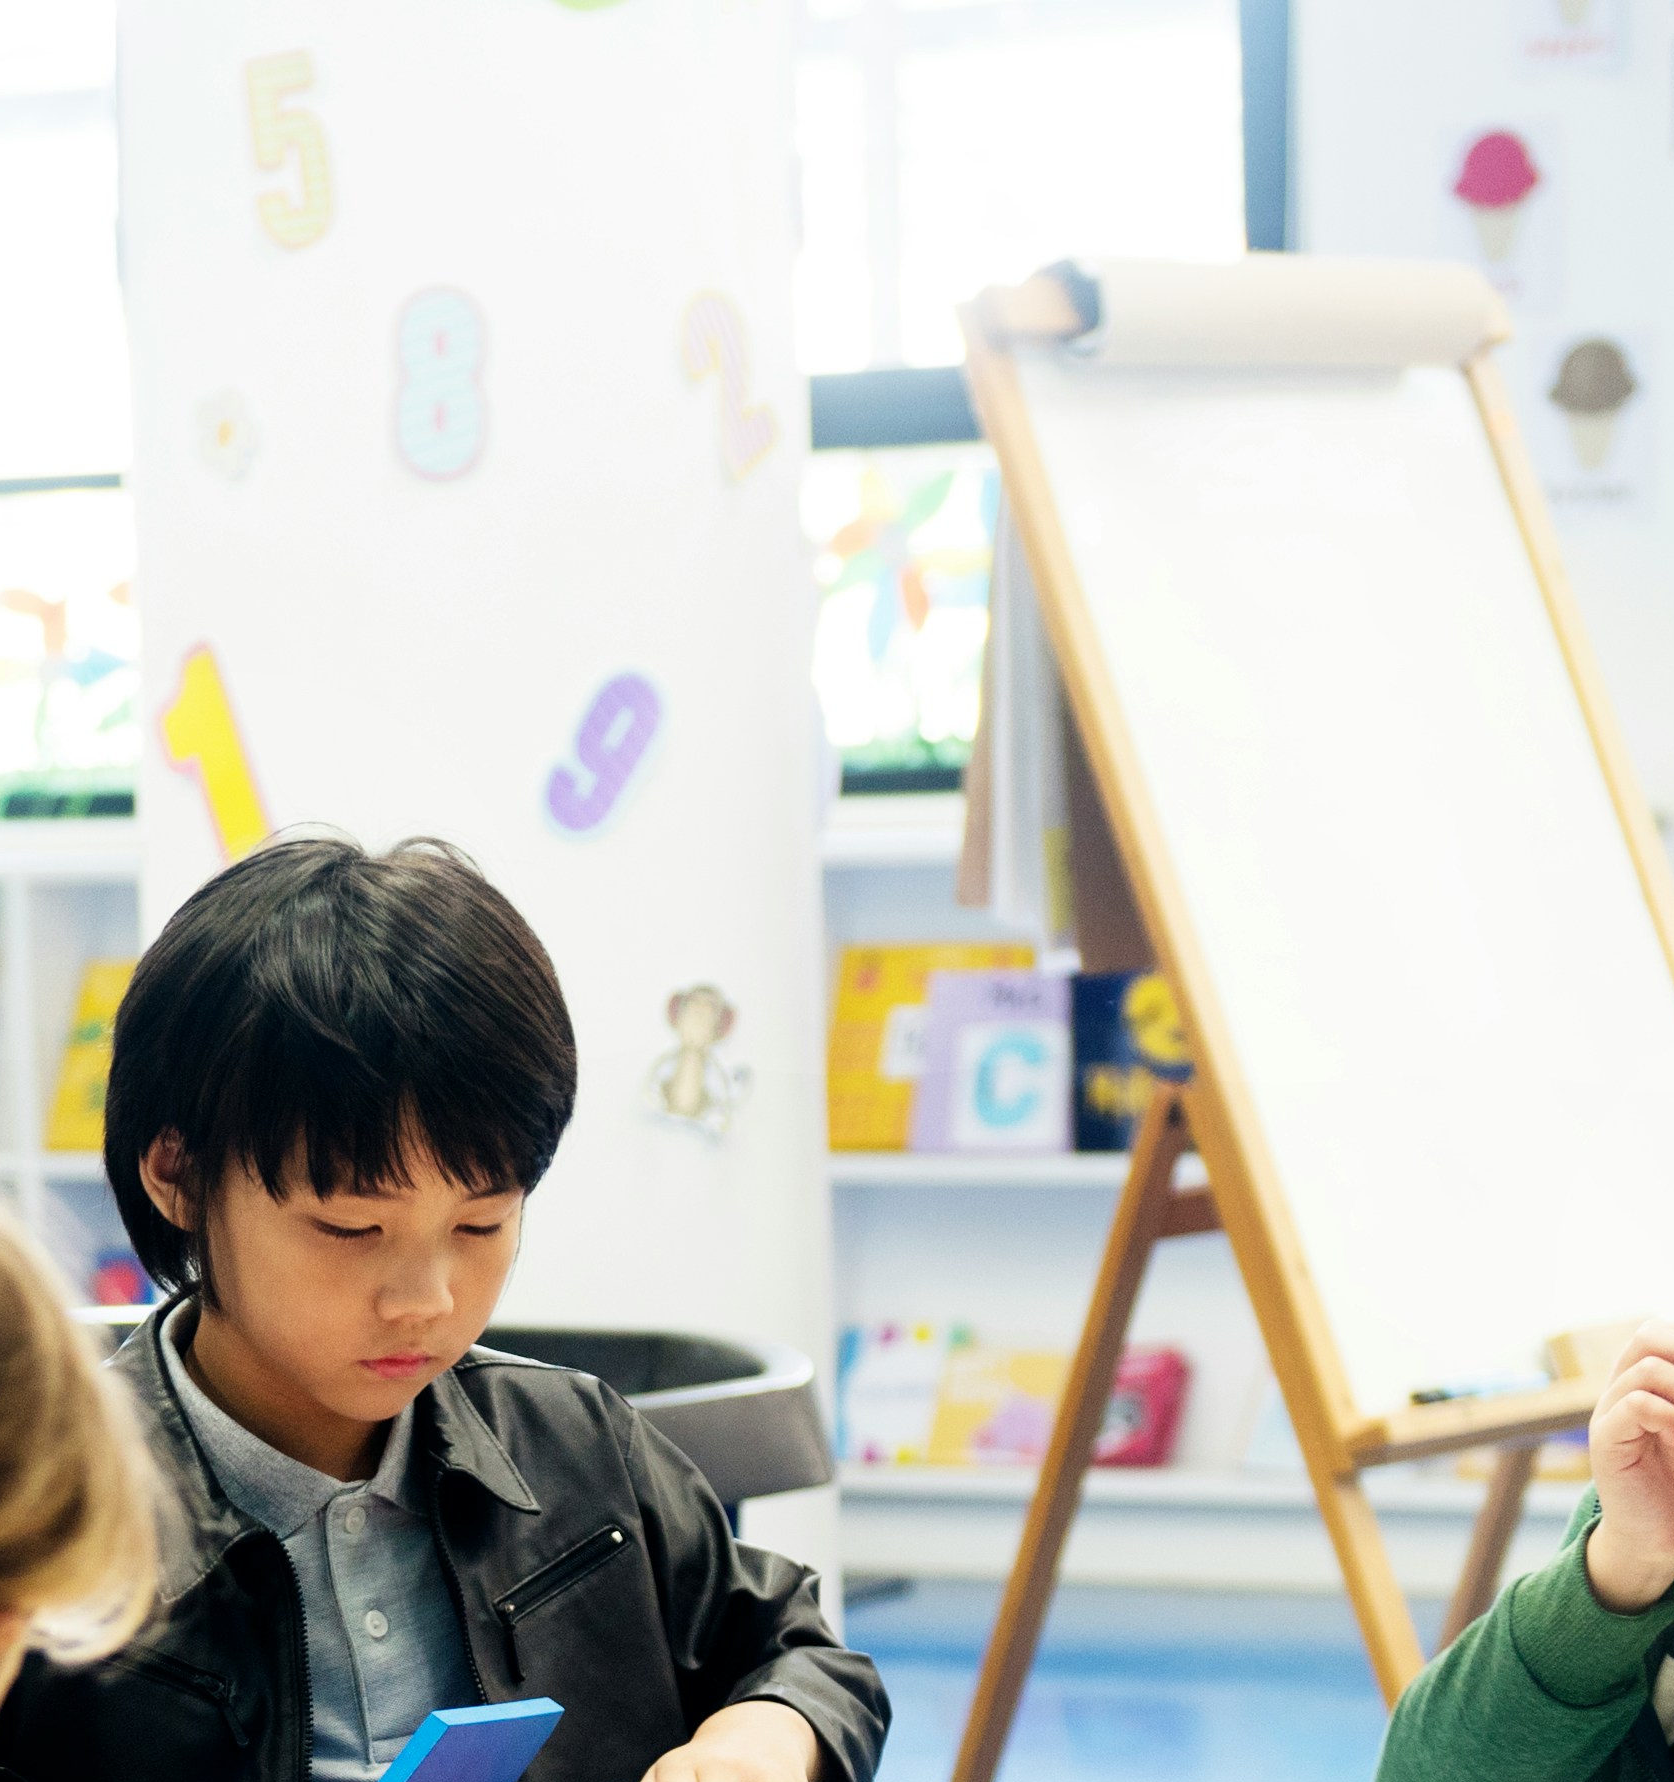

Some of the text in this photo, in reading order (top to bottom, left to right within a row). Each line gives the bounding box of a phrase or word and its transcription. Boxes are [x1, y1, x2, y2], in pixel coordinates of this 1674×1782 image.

[245, 49, 333, 250] 5
[392, 283, 488, 484] 8
[681, 288, 779, 485] 2
[159, 640, 275, 866] 1
[545, 666, 663, 834] 9
[973, 1028, 1047, 1130] C
